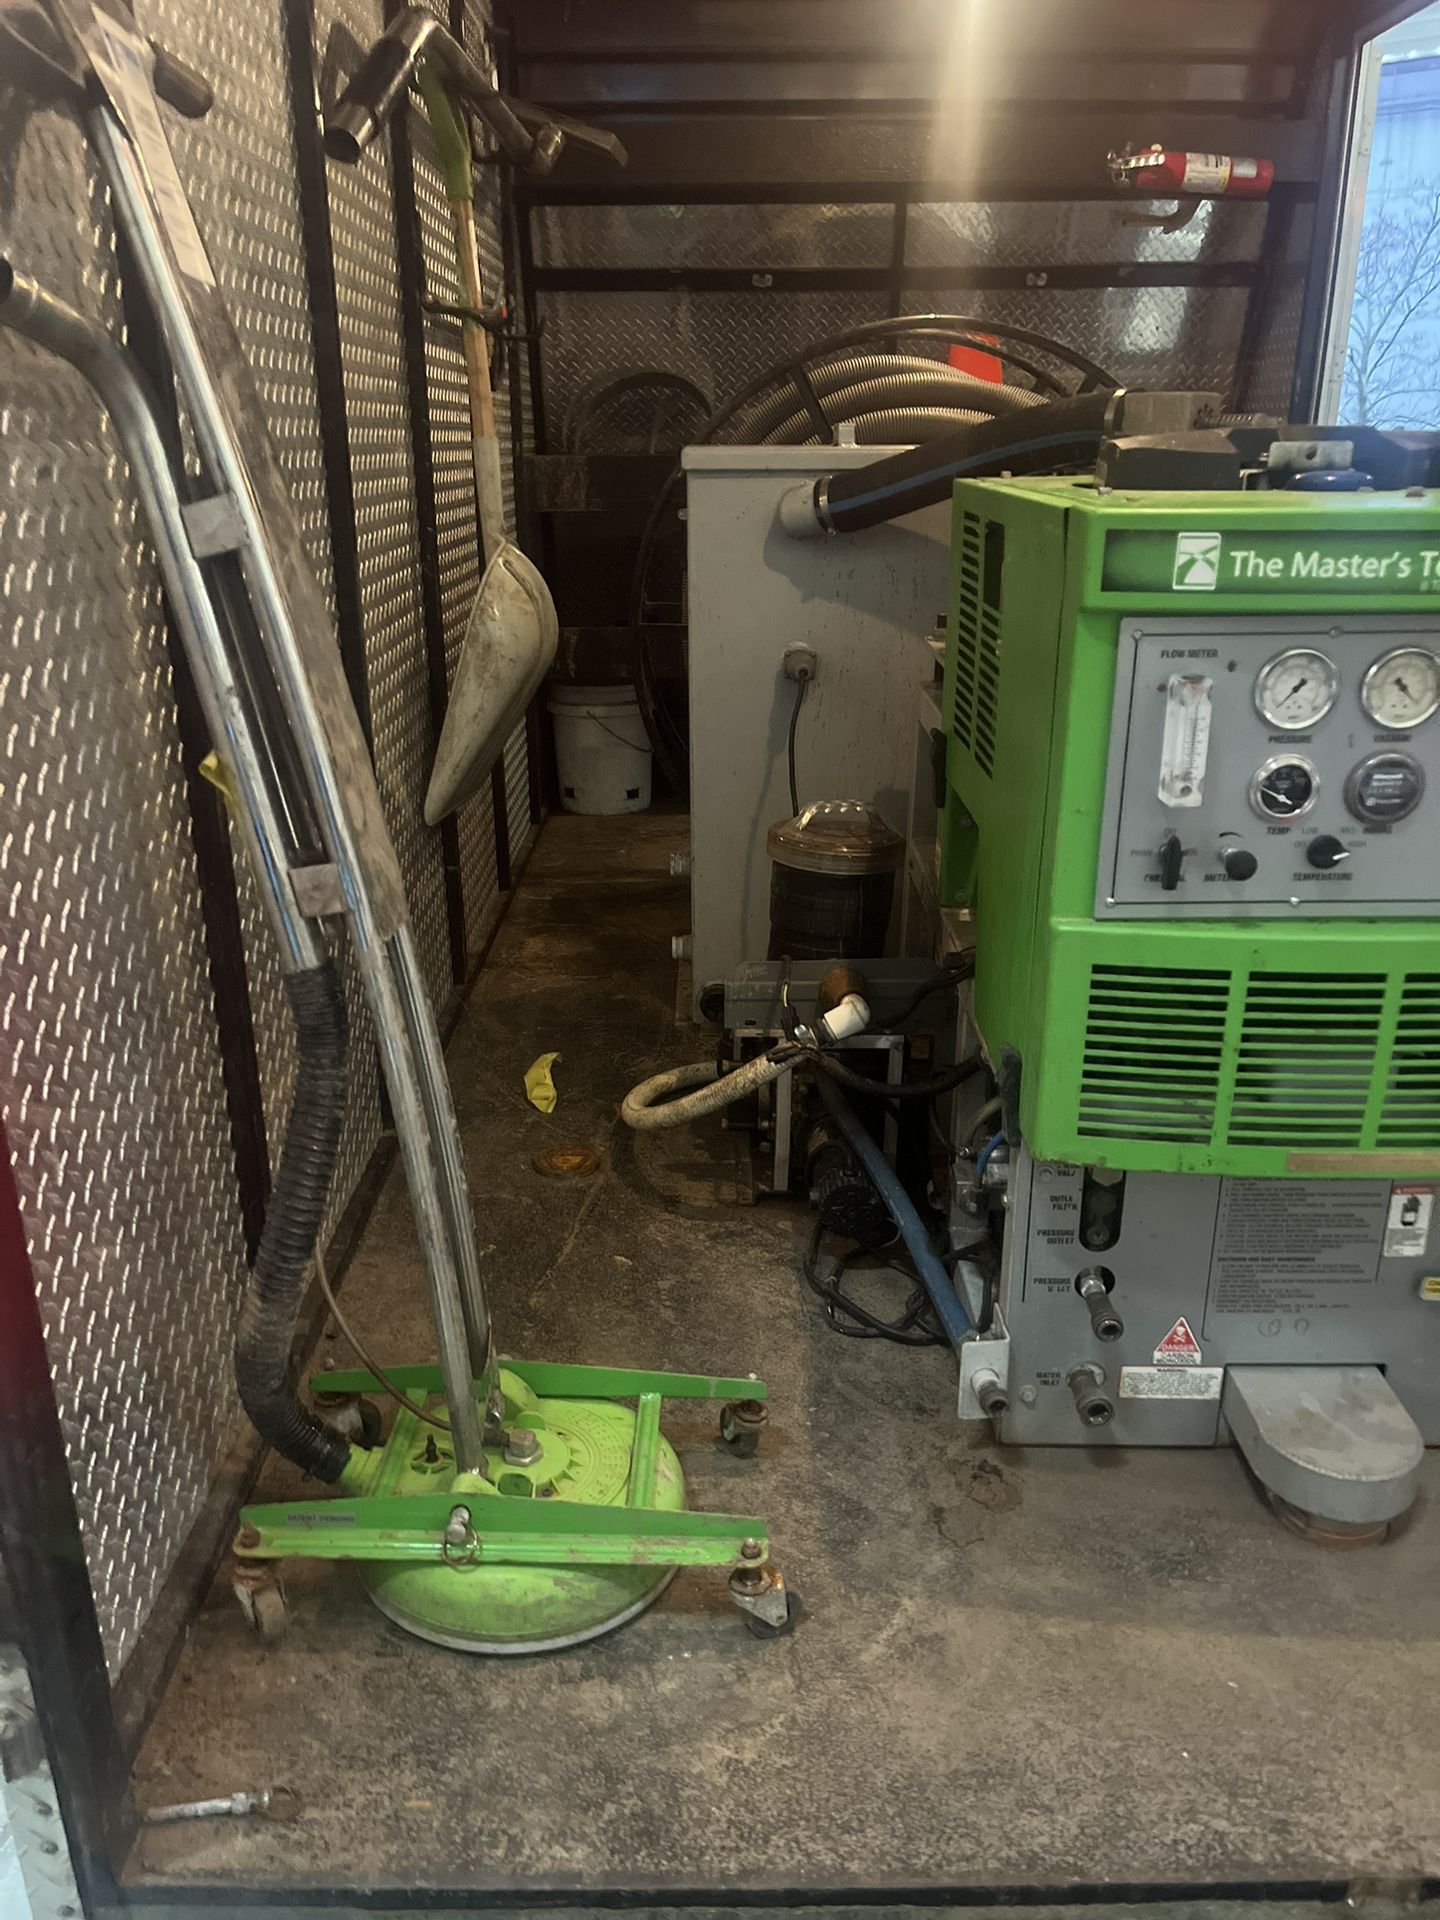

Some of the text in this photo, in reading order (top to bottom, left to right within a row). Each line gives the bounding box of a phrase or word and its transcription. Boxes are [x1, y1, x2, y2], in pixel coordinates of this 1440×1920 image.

[1229, 550, 1440, 578] The Master's T
